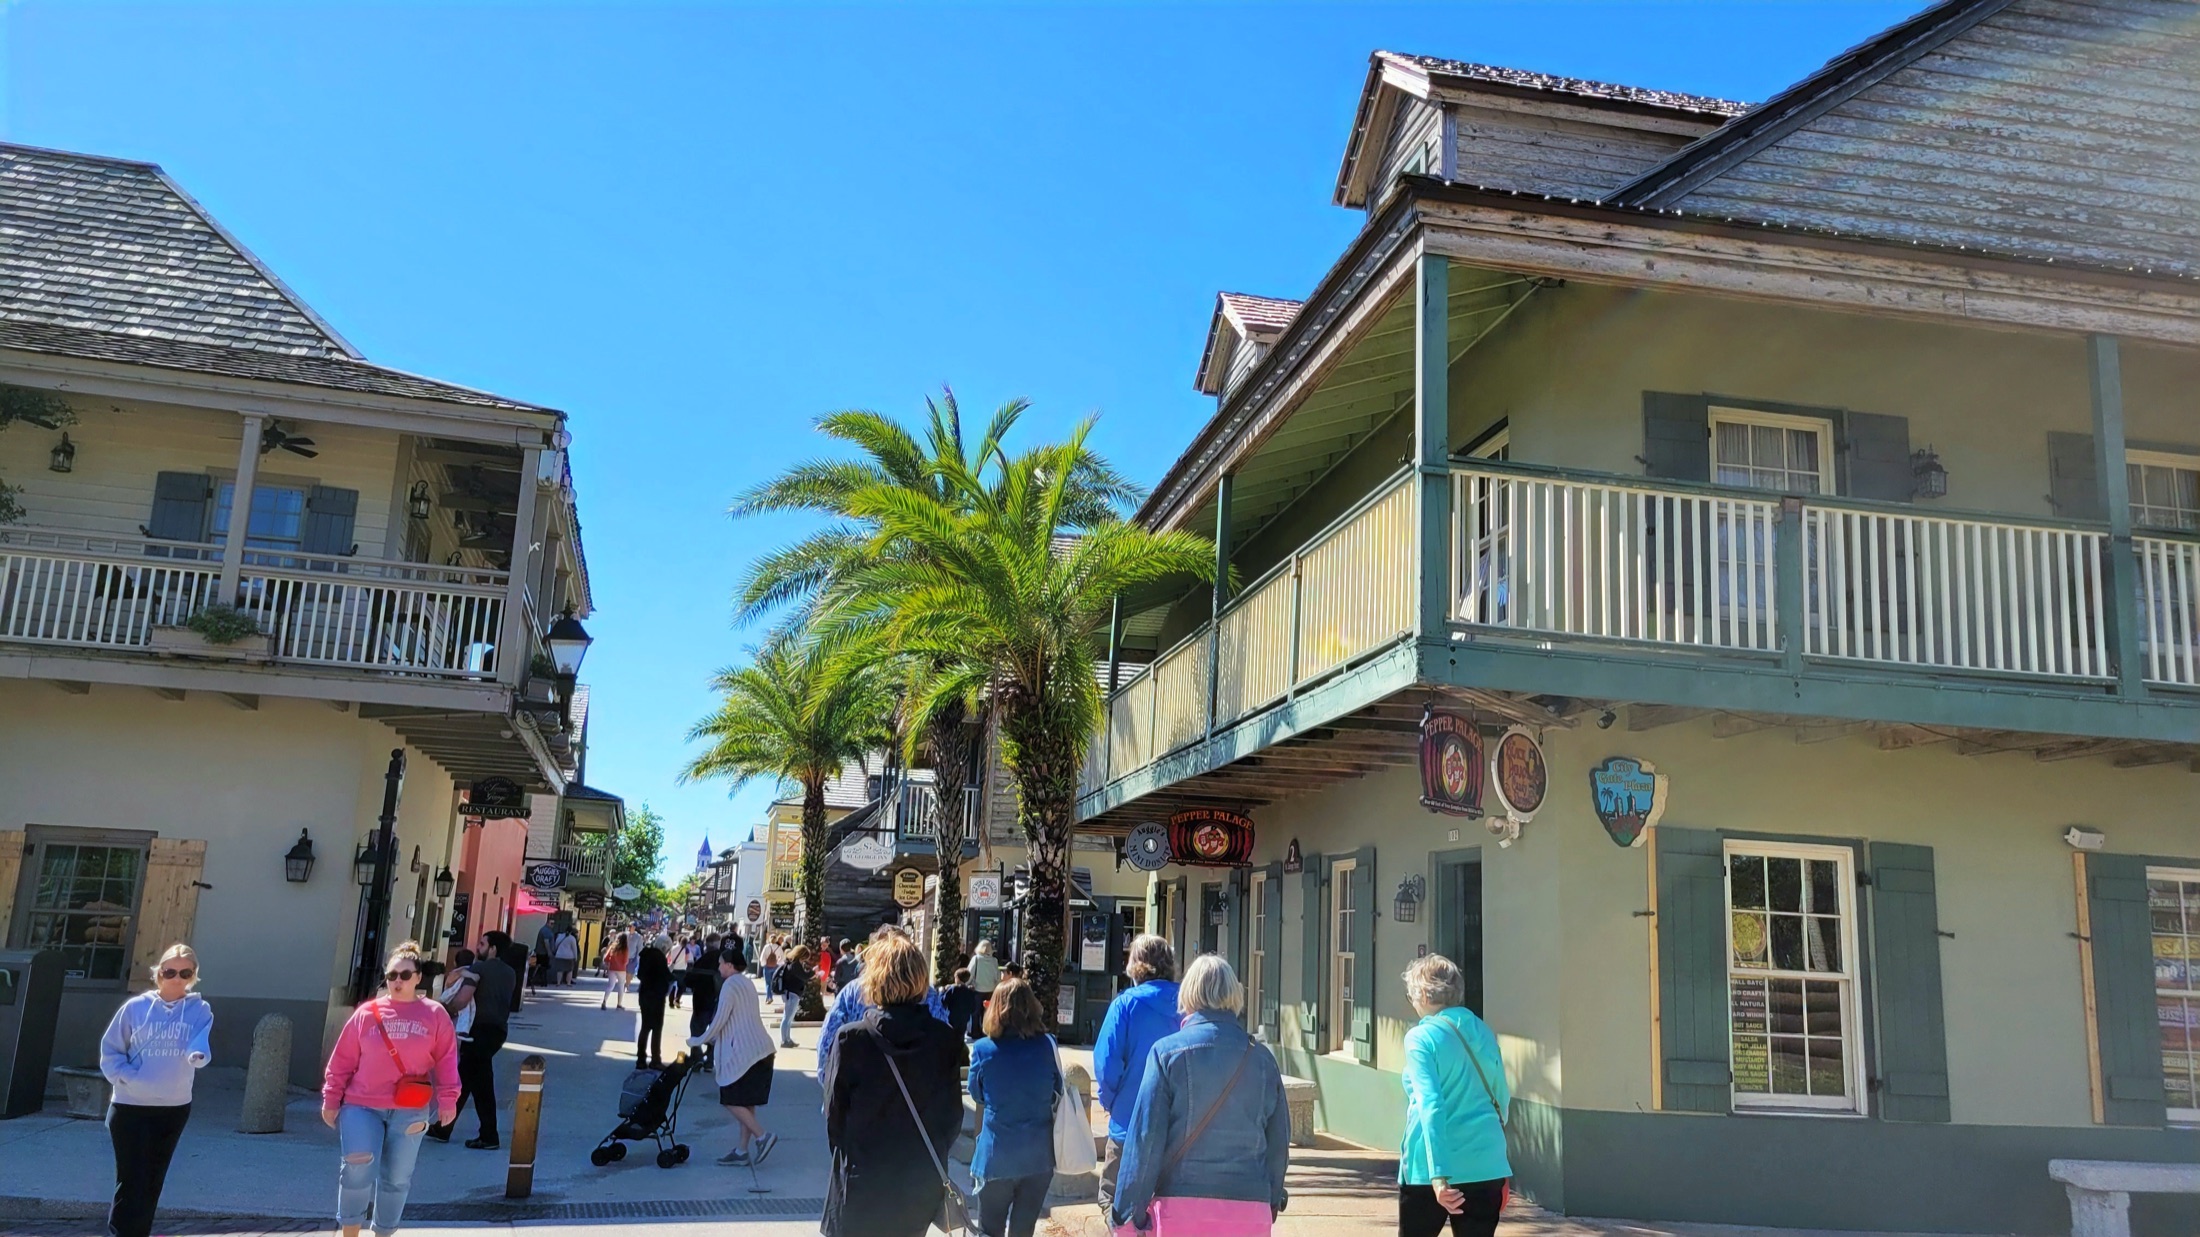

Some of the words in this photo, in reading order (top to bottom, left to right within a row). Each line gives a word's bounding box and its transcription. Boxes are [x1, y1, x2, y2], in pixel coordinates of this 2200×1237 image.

[1424, 716, 1453, 739] PEPPER
[1455, 718, 1483, 753] PALACE
[1613, 762, 1633, 774] City
[1600, 773, 1622, 784] Gate
[1623, 780, 1652, 791] Plaza
[461, 805, 528, 817] RESTAURANT
[1170, 810, 1211, 825] PEPPER
[1213, 811, 1254, 830] PALACE
[1137, 825, 1166, 837] Auggie's
[1130, 844, 1144, 865] MINI
[535, 875, 557, 883] DRAFT
[147, 1021, 194, 1042] AUGUSTI
[141, 1048, 186, 1057] FLORIDA
